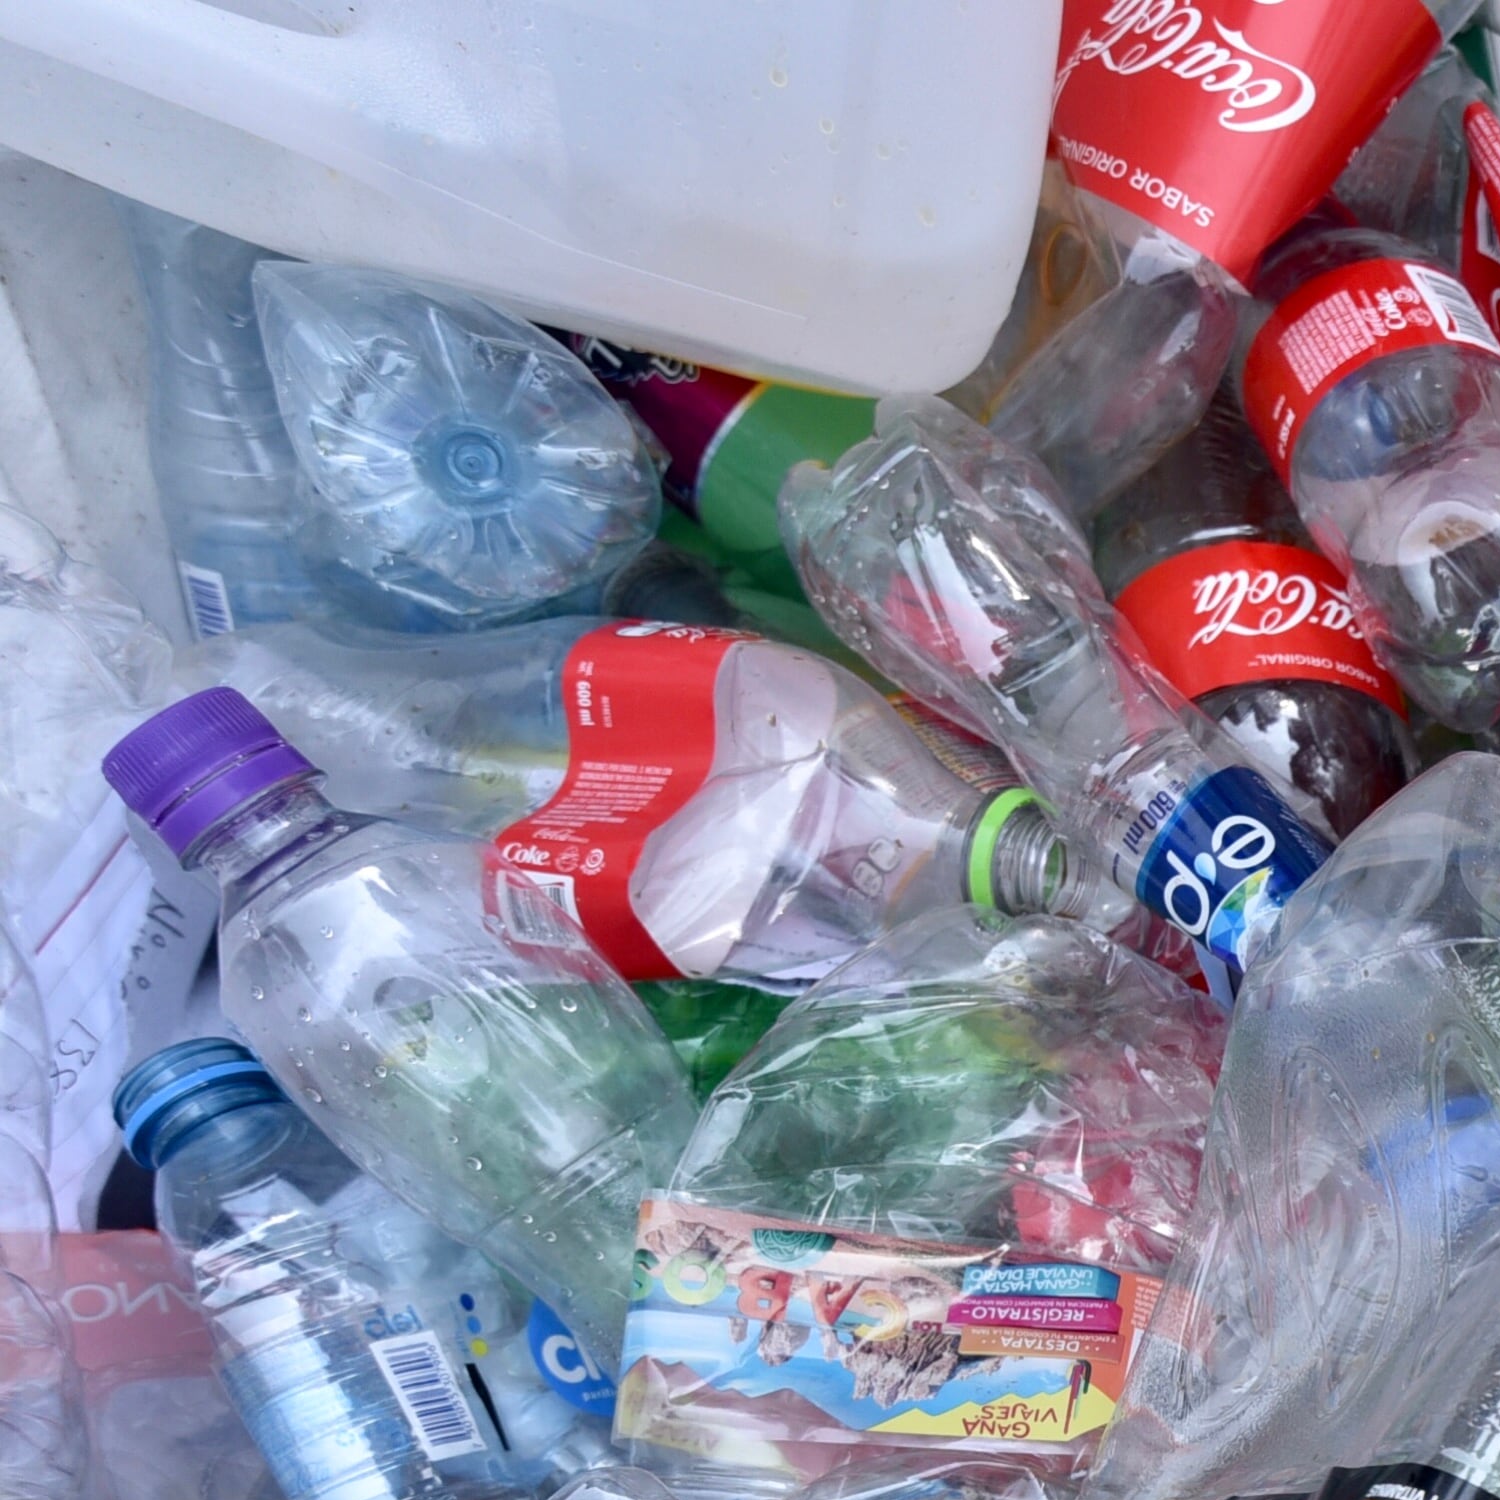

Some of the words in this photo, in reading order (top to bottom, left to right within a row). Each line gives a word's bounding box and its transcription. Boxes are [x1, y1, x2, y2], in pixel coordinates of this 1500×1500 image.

[1057, 138, 1128, 184] ORIGINAL
[1127, 174, 1214, 228] SABOR
[1183, 560, 1370, 668] ca-Cola
[575, 680, 592, 705] 600
[579, 708, 594, 725] ml
[1133, 788, 1179, 832] 600
[1117, 821, 1152, 856] ml
[501, 841, 552, 867] Coke
[968, 1261, 1023, 1286] DIARIO
[982, 1275, 1032, 1296] HASTA
[1025, 1264, 1067, 1283] VIAJE
[1034, 1274, 1080, 1294] GANA
[1069, 1267, 1093, 1280] UN
[911, 1318, 942, 1334] LOS
[999, 1330, 1080, 1357] DESTAPA
[977, 1397, 1058, 1430] VIAJES
[959, 1414, 1030, 1444] GANA
